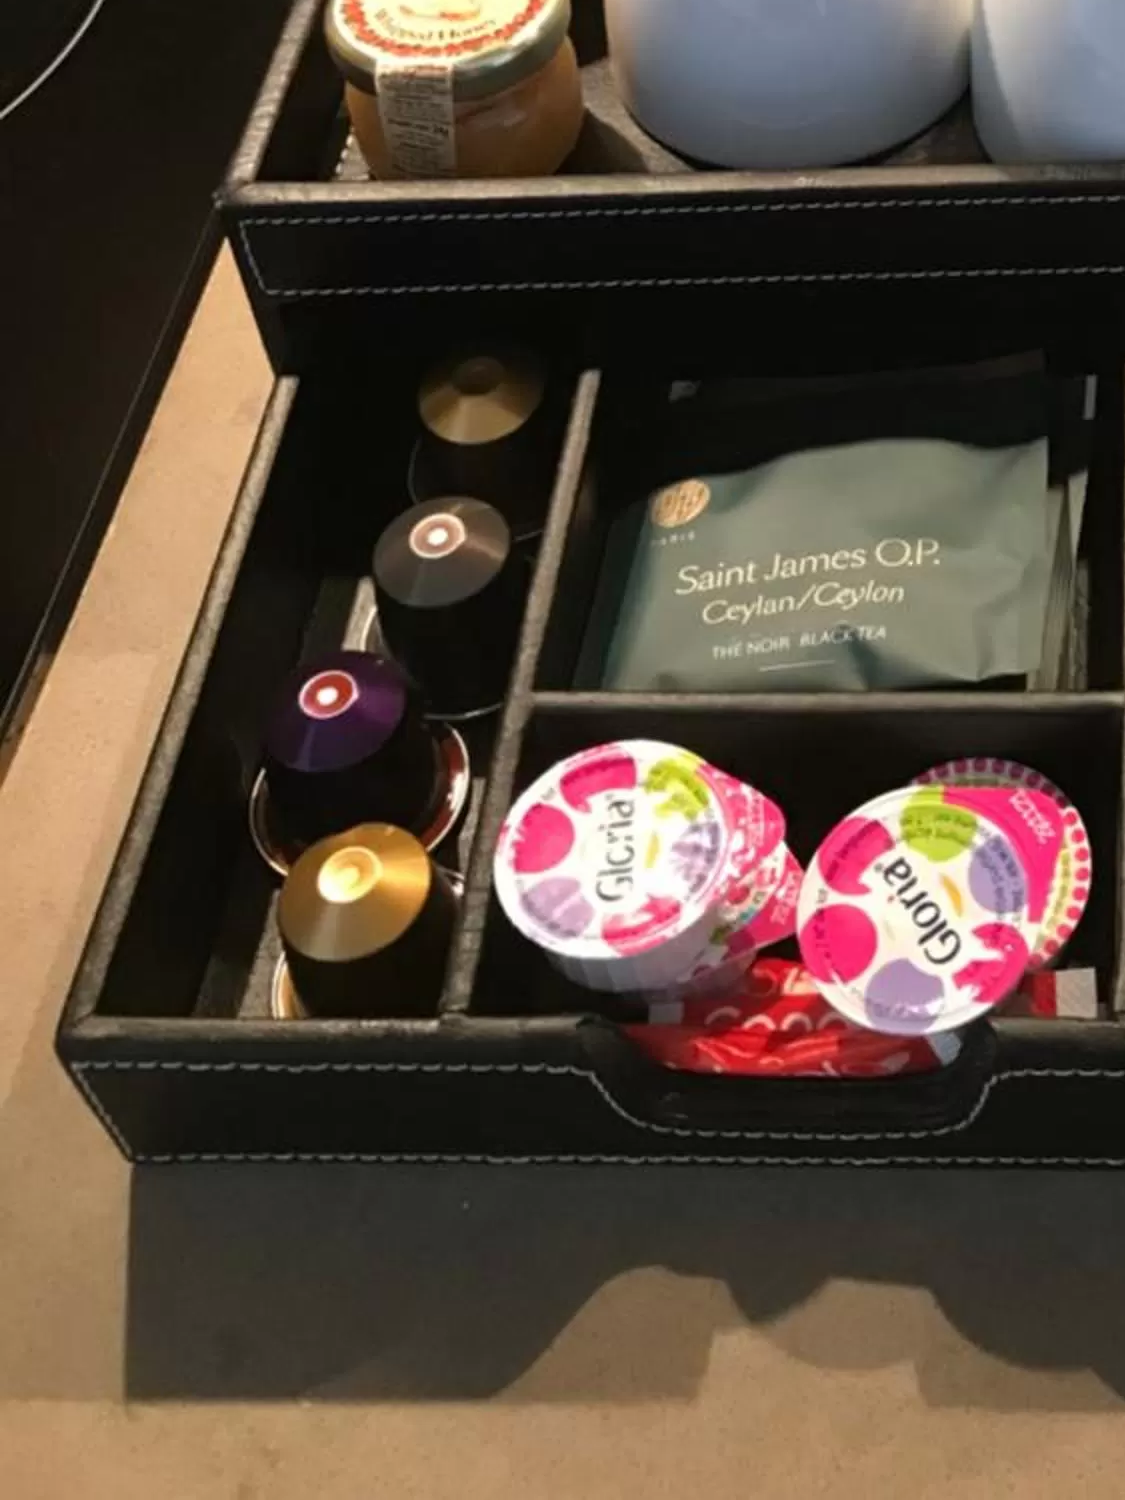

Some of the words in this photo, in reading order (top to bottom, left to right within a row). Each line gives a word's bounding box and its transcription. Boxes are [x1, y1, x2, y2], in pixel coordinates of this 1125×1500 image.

[674, 559, 757, 595] Saint
[764, 547, 867, 582] James
[874, 537, 941, 568] O.P.
[702, 579, 905, 625] Ceylan/Ceylon
[746, 635, 790, 656] NOIR
[800, 627, 854, 648] BLACK
[857, 625, 887, 641] TEA
[595, 799, 636, 902] Gloria
[882, 856, 962, 966] Gloria
